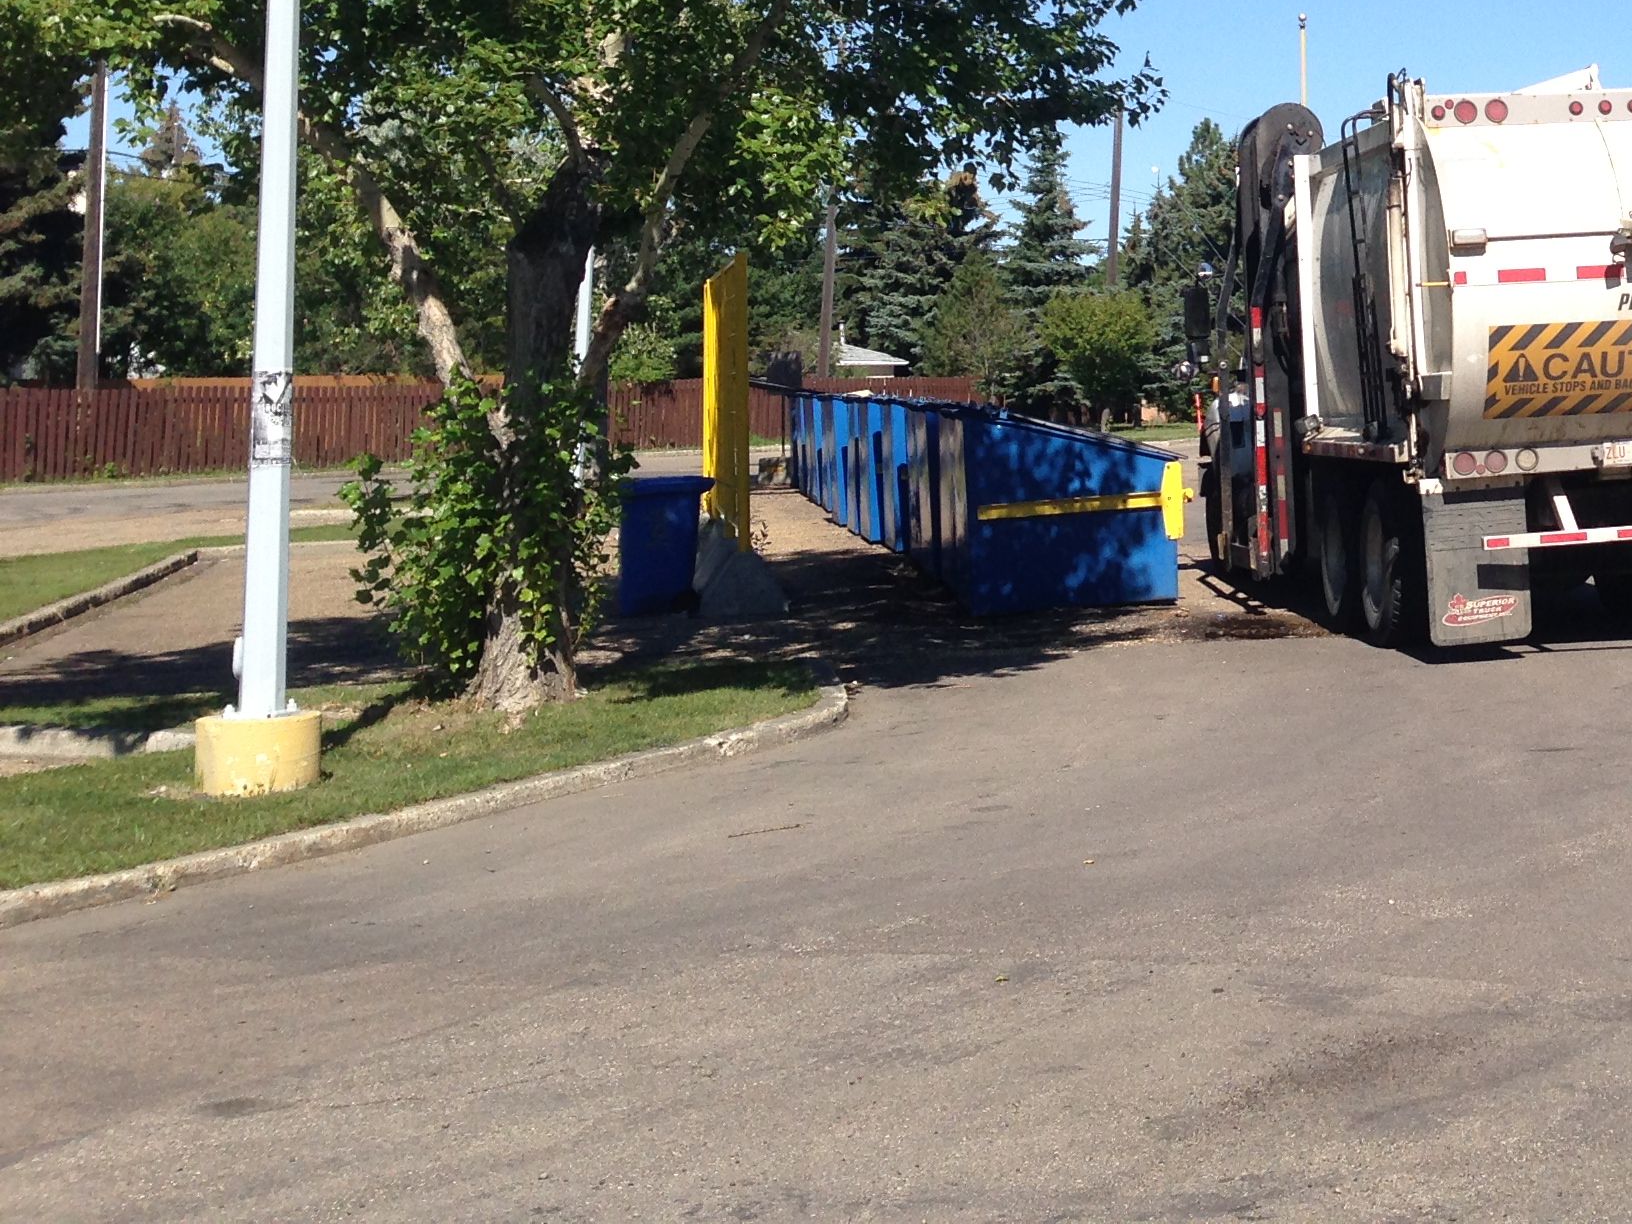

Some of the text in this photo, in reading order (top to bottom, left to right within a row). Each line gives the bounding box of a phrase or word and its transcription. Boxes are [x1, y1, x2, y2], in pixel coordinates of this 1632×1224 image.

[1504, 382, 1549, 396] VEHICLE
[1552, 380, 1586, 394] STOPS
[1590, 378, 1612, 391] AND
[1464, 597, 1516, 610] SUPERIOR
